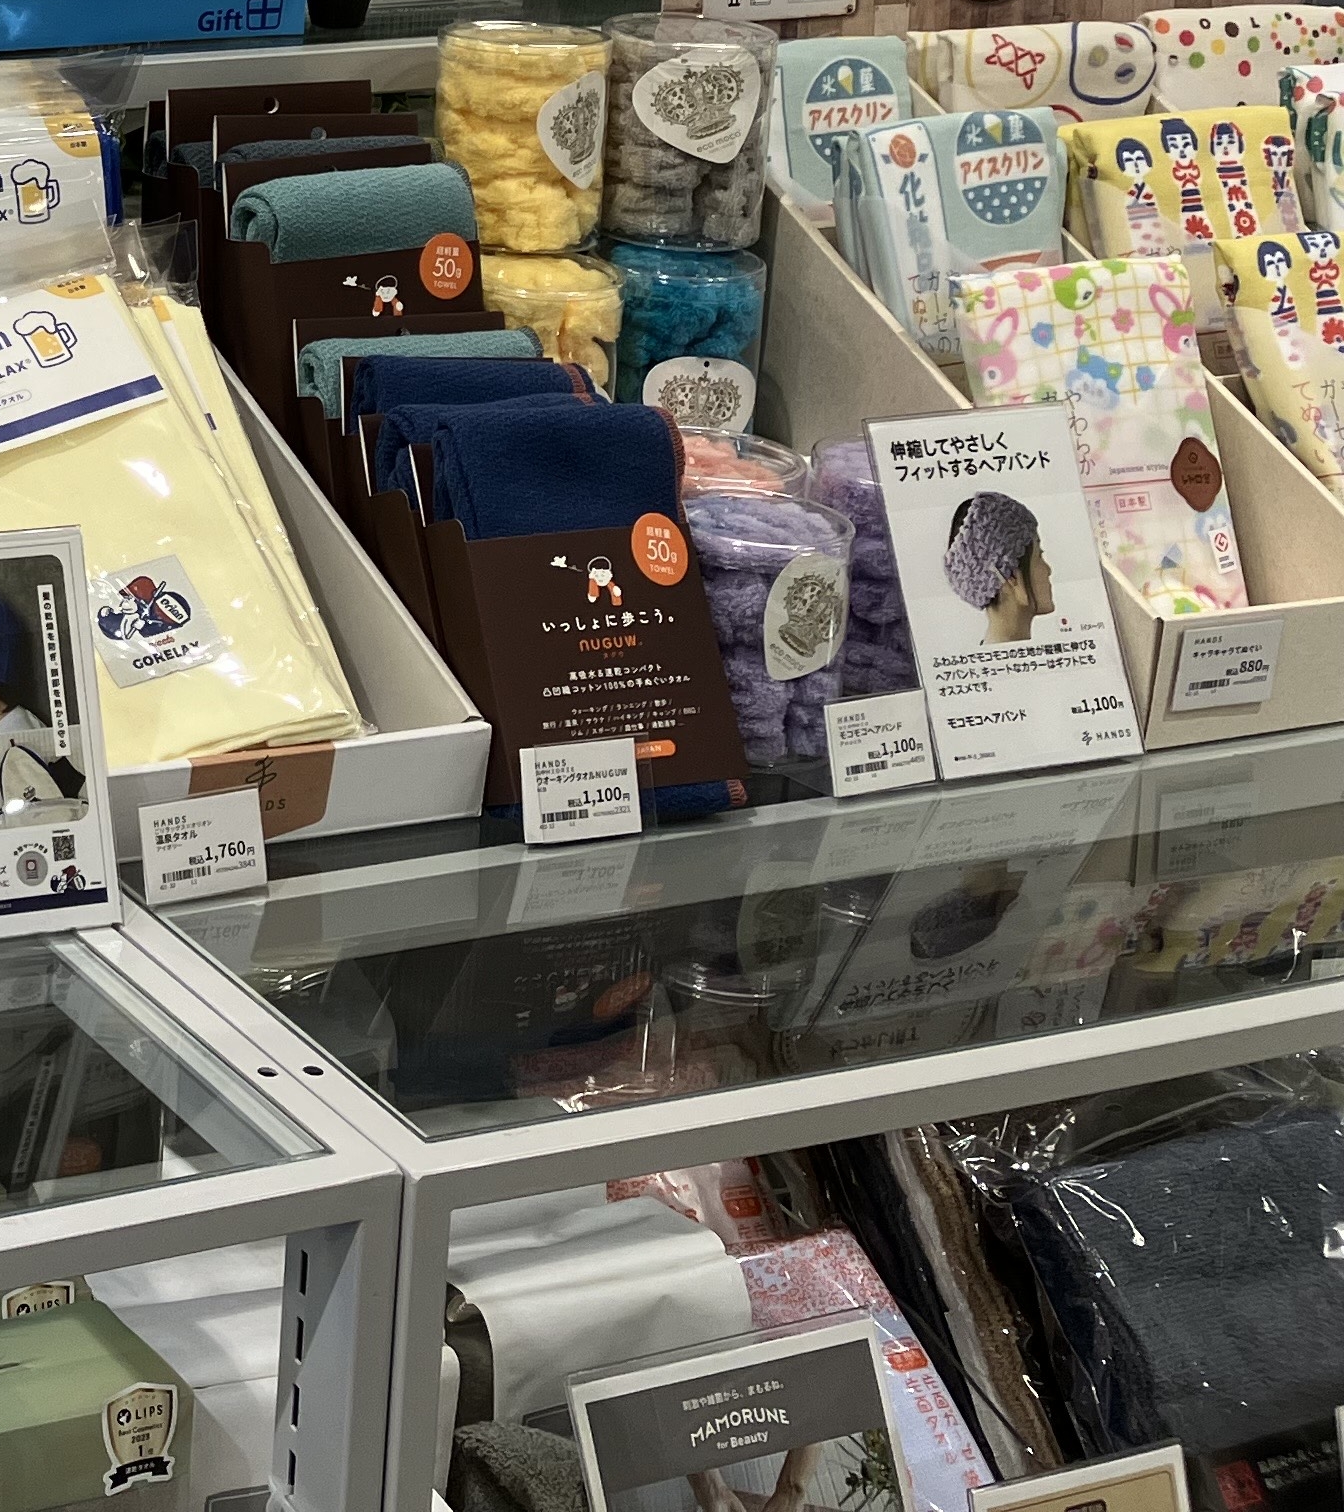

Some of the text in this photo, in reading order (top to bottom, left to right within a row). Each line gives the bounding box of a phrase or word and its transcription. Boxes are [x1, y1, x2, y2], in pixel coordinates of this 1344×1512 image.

[197, 8, 244, 33] Gift
[808, 101, 894, 127] アイスクリン
[960, 148, 1045, 178] アイスクリン
[433, 257, 463, 280] 50g
[432, 280, 459, 290] TOWEL
[889, 431, 1009, 462] 伸縮してやさしく
[893, 450, 1052, 483] フィットするヘアバンド
[645, 526, 671, 539] 超軽量
[646, 539, 678, 563] 50g
[649, 564, 676, 576] TOWEL
[542, 607, 676, 633] いっしょに歩こう。
[1193, 635, 1224, 646] HANDS
[946, 708, 1028, 730] モコモコヘアバンド
[839, 722, 904, 739] モコモコヘアバンド
[1095, 728, 1132, 741] HANDS
[534, 759, 568, 770] HANDS
[567, 786, 630, 808] 税込1,100円
[153, 815, 187, 828] HANDS
[155, 829, 198, 845] 温泉タオル
[188, 840, 256, 865] 税込1,760円
[133, 1402, 165, 1422] LIPS
[690, 1408, 790, 1448] MAMORUNE
[716, 1430, 770, 1450] for Beauty
